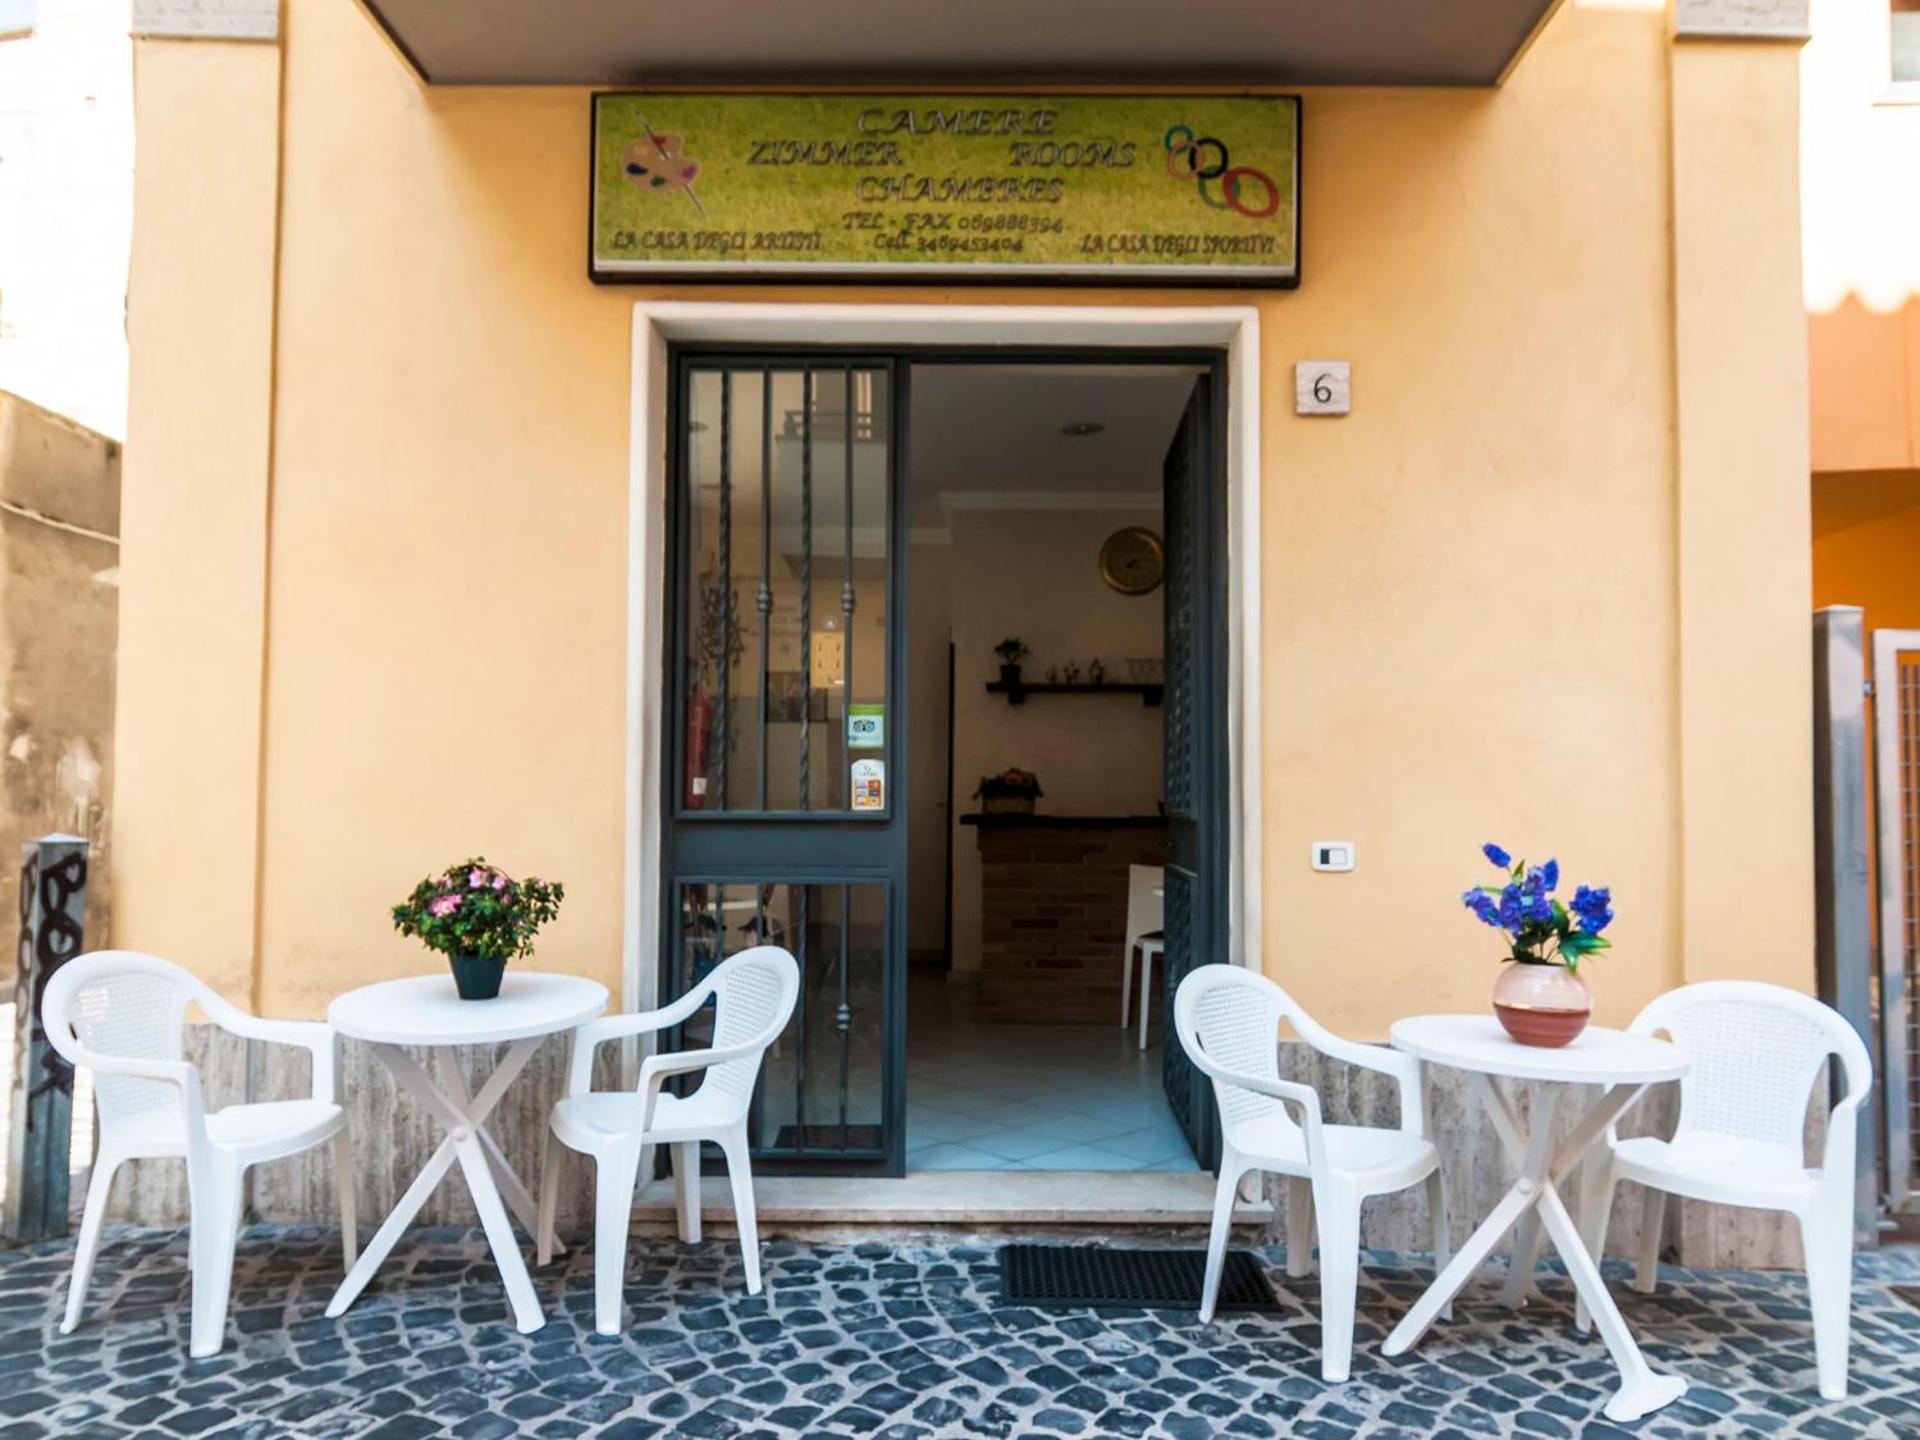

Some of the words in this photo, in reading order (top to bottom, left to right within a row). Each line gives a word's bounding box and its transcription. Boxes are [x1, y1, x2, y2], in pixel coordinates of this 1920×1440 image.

[856, 107, 1059, 136] CAMERE
[746, 139, 904, 167] ZIMMER
[1008, 141, 1138, 168] ROOMS
[855, 174, 1065, 202] CHAMBRES
[903, 211, 953, 236] FAX
[612, 230, 637, 250] LA
[641, 230, 690, 250] CASA
[693, 230, 747, 254] DEGLI
[751, 230, 822, 251] ARTISTI
[1080, 233, 1104, 253] LA
[1106, 233, 1150, 253] CASA
[1152, 234, 1199, 256] DEGLI
[1313, 373, 1332, 404] 6
